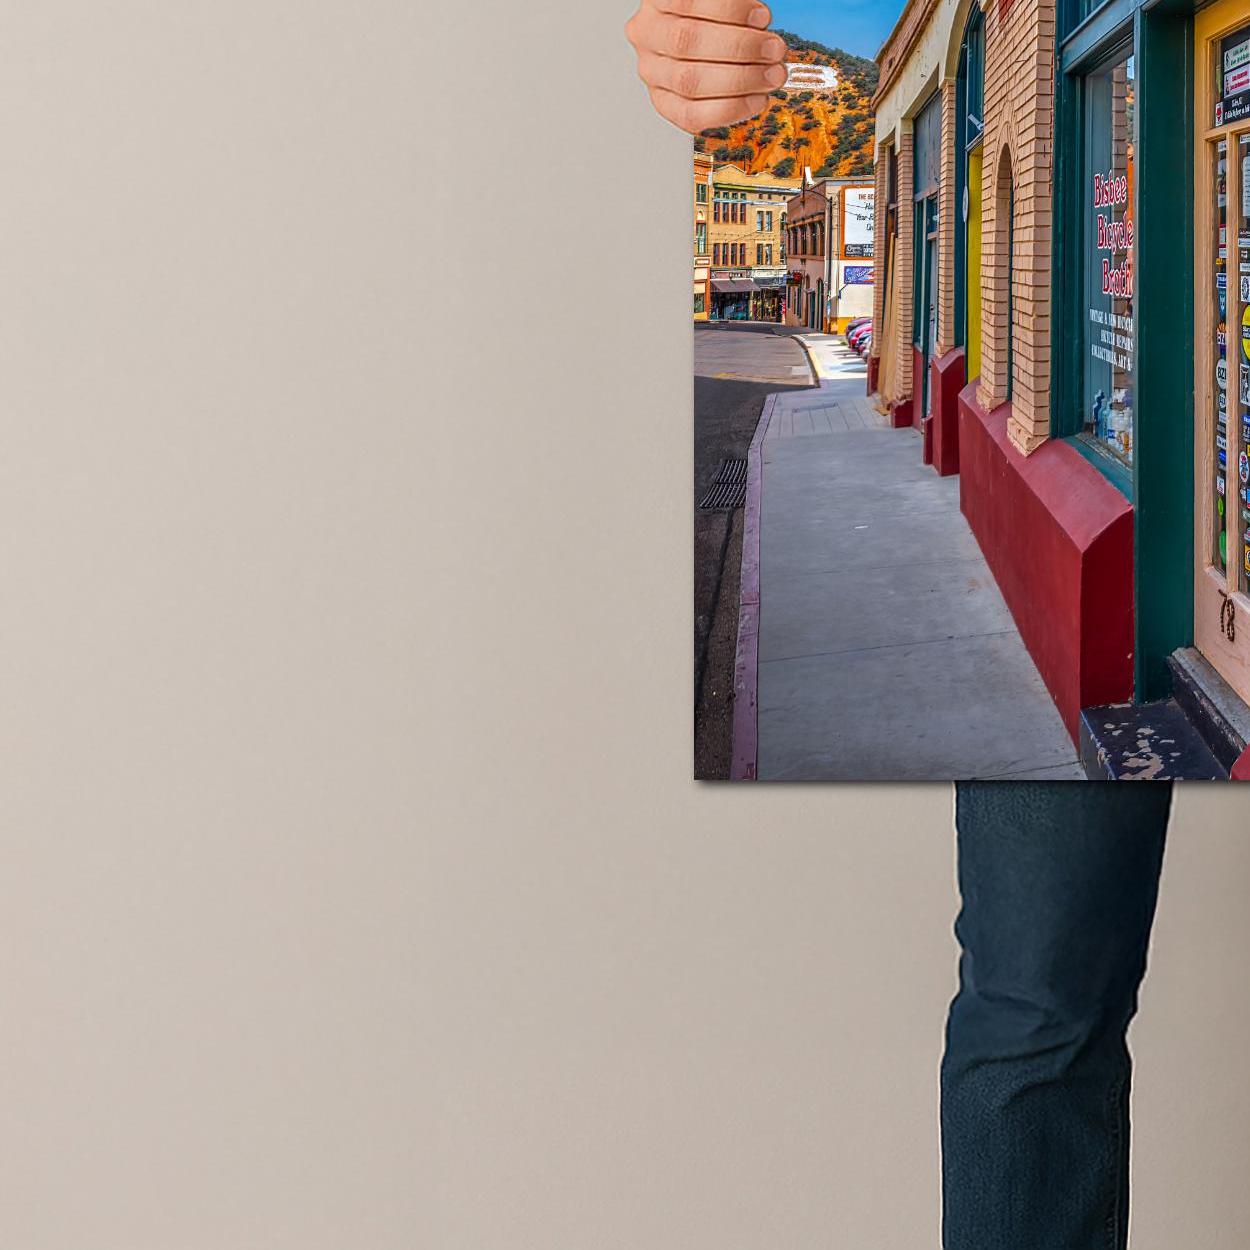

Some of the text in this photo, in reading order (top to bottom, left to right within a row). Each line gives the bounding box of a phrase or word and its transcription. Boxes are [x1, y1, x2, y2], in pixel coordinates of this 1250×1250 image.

[1094, 170, 1128, 207] Bisbee
[1097, 211, 1134, 254] Bicycle
[1217, 588, 1235, 642] 78
